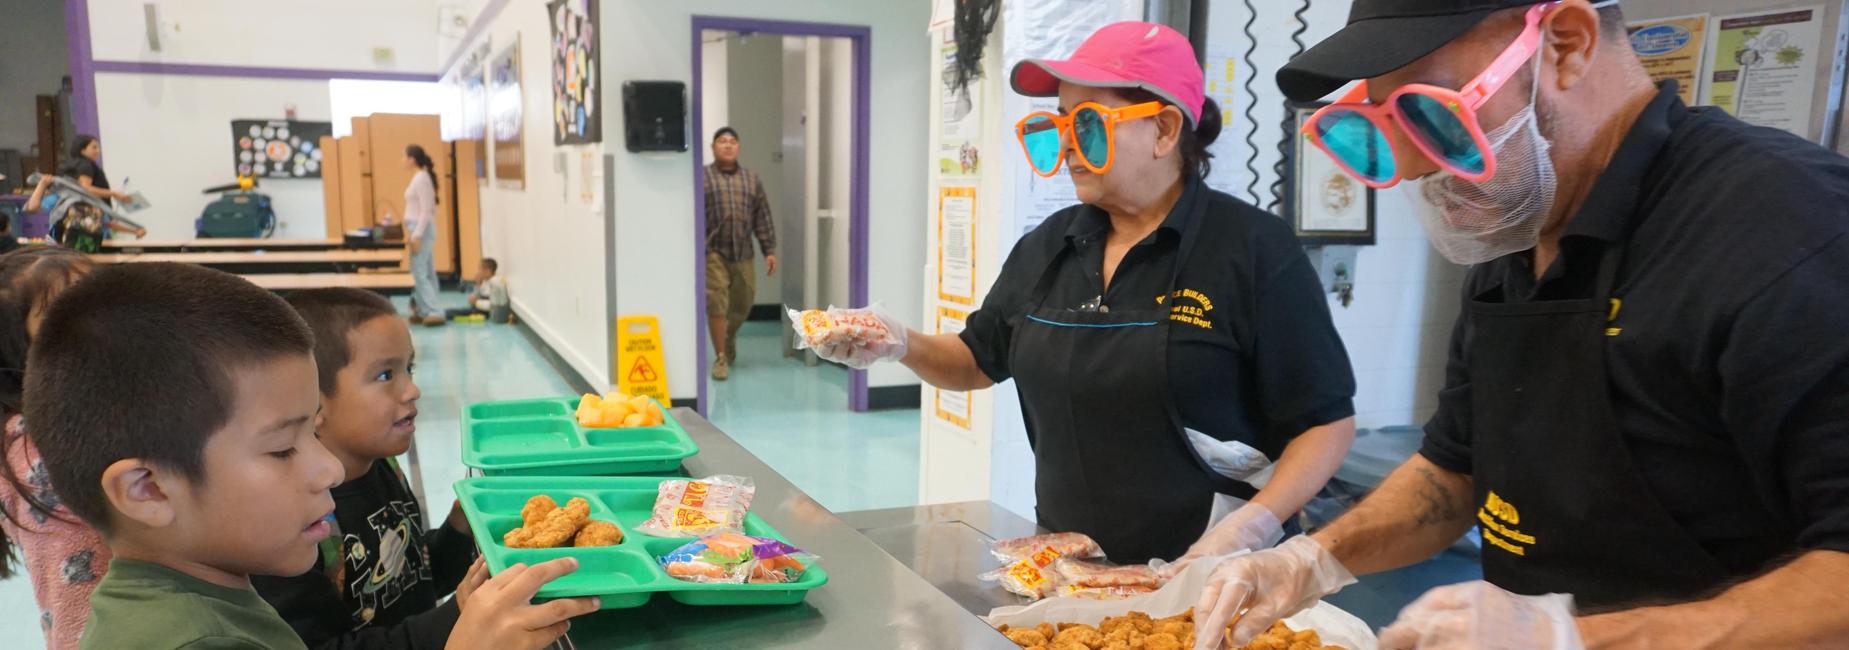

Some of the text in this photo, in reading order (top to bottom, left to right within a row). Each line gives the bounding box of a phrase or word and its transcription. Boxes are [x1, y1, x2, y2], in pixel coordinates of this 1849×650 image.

[1183, 289, 1213, 311] BUILDERS
[1170, 314, 1212, 328] ervice Dept.
